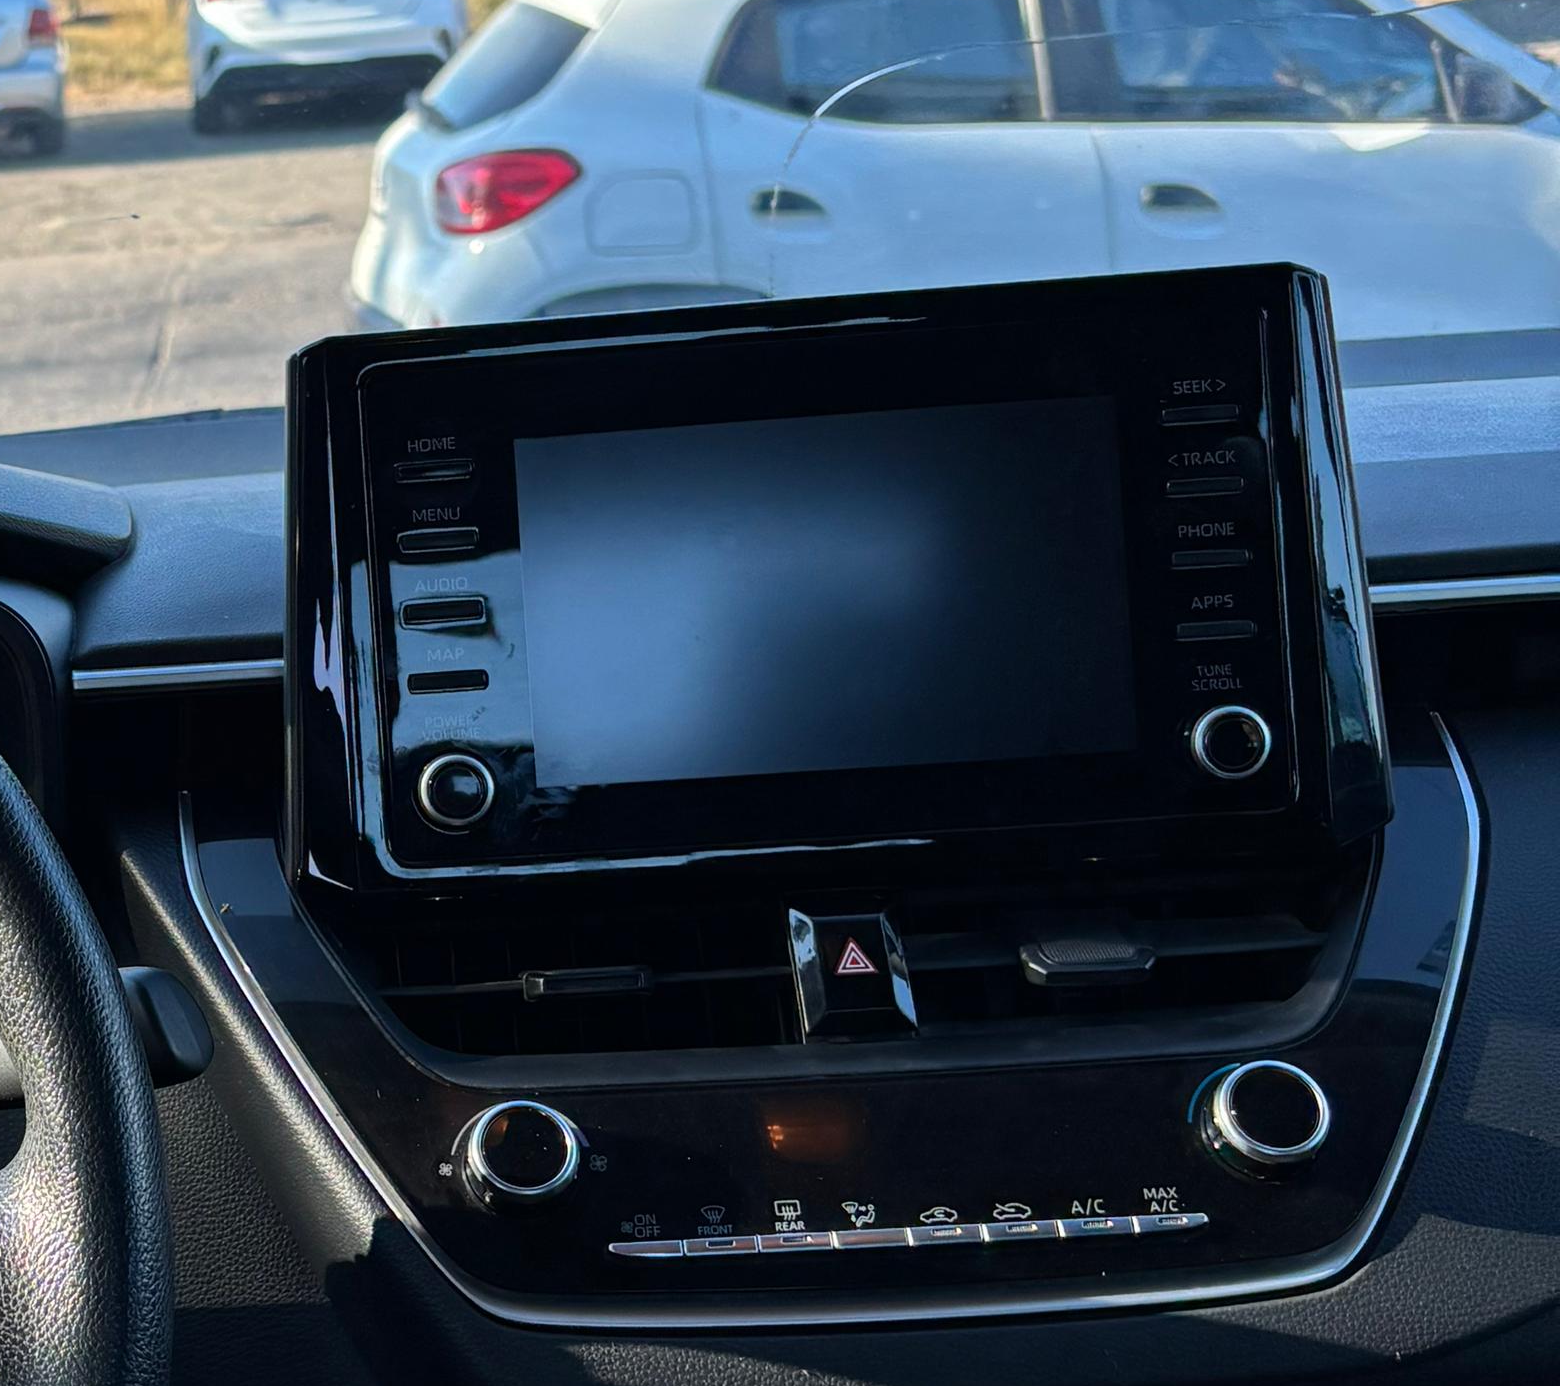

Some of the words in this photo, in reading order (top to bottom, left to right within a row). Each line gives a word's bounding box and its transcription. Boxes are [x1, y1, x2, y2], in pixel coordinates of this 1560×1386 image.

[406, 436, 457, 453] HOME
[1181, 449, 1237, 467] TRACK
[411, 506, 462, 524] MENU
[1177, 521, 1237, 539] PHONE
[414, 576, 469, 593] AUDIO
[1190, 593, 1235, 611] APPS
[426, 646, 466, 663] MAP
[1195, 662, 1233, 677] TUNE
[1191, 676, 1243, 693] SCROLL
[1142, 1185, 1179, 1201] MAX
[1071, 1198, 1105, 1215] A/C
[1149, 1199, 1180, 1214] A/C
[633, 1213, 658, 1227] ON
[774, 1219, 806, 1233] REAR
[634, 1225, 662, 1239] OFF
[696, 1223, 734, 1237] FRONT
